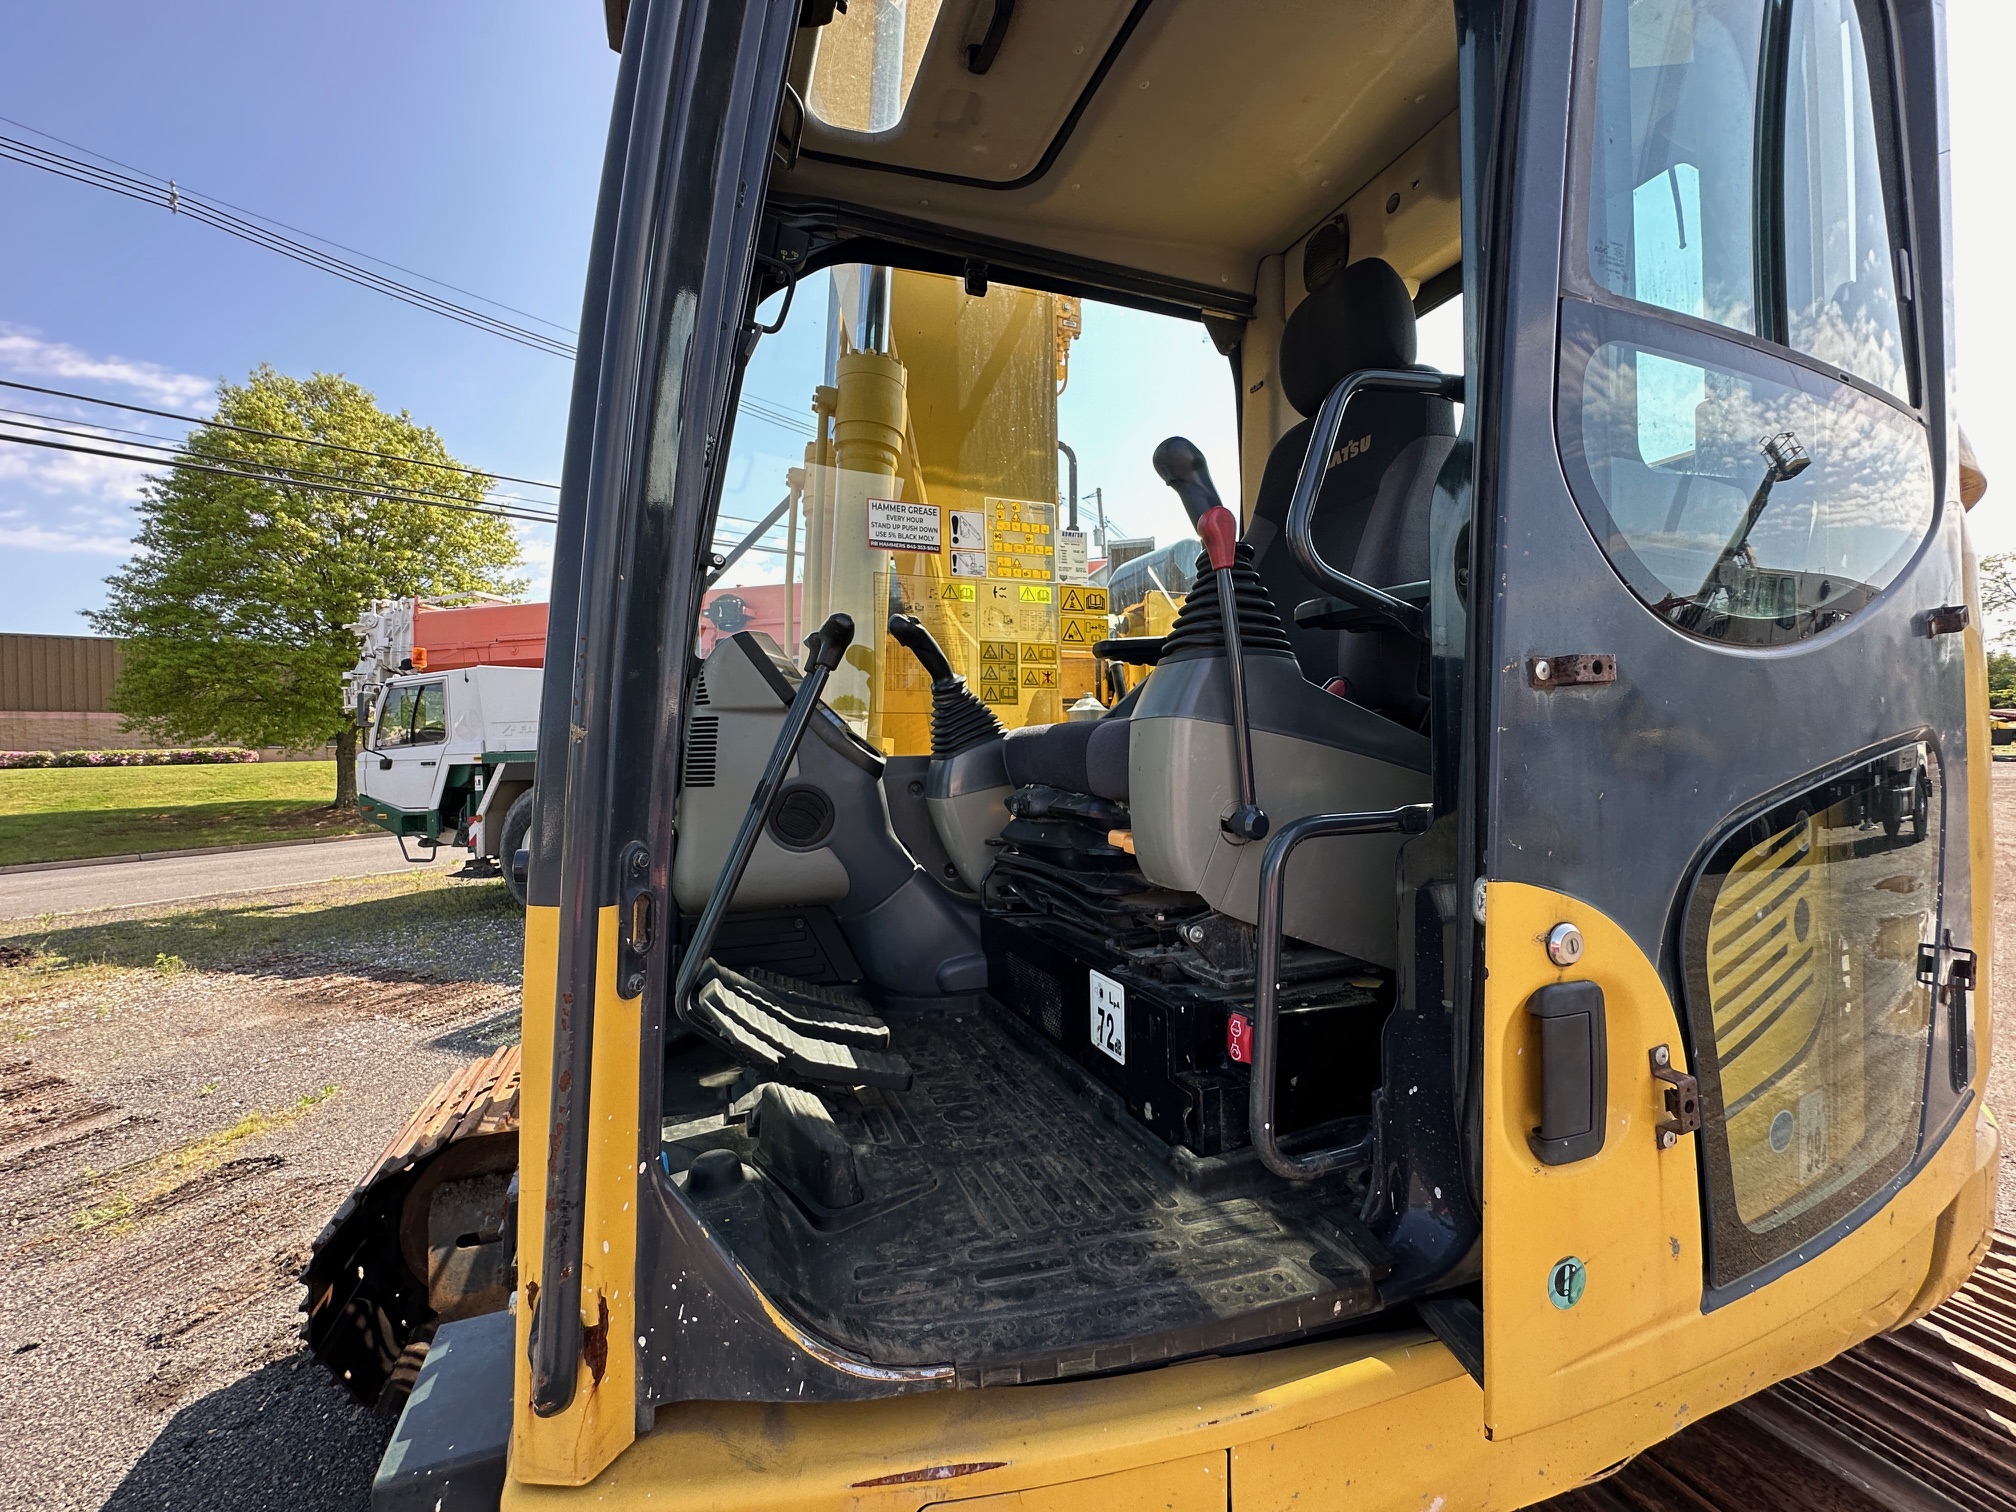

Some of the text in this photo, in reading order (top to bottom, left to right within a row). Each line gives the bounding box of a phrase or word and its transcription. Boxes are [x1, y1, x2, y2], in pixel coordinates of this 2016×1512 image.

[1327, 434, 1371, 469] ATSU
[871, 502, 938, 517] HAMMER GREASE
[906, 516, 924, 524] HOUR
[871, 521, 891, 529] STAND
[901, 524, 918, 532] PUSH
[897, 532, 918, 540] BLACK
[918, 534, 935, 542] MOLY
